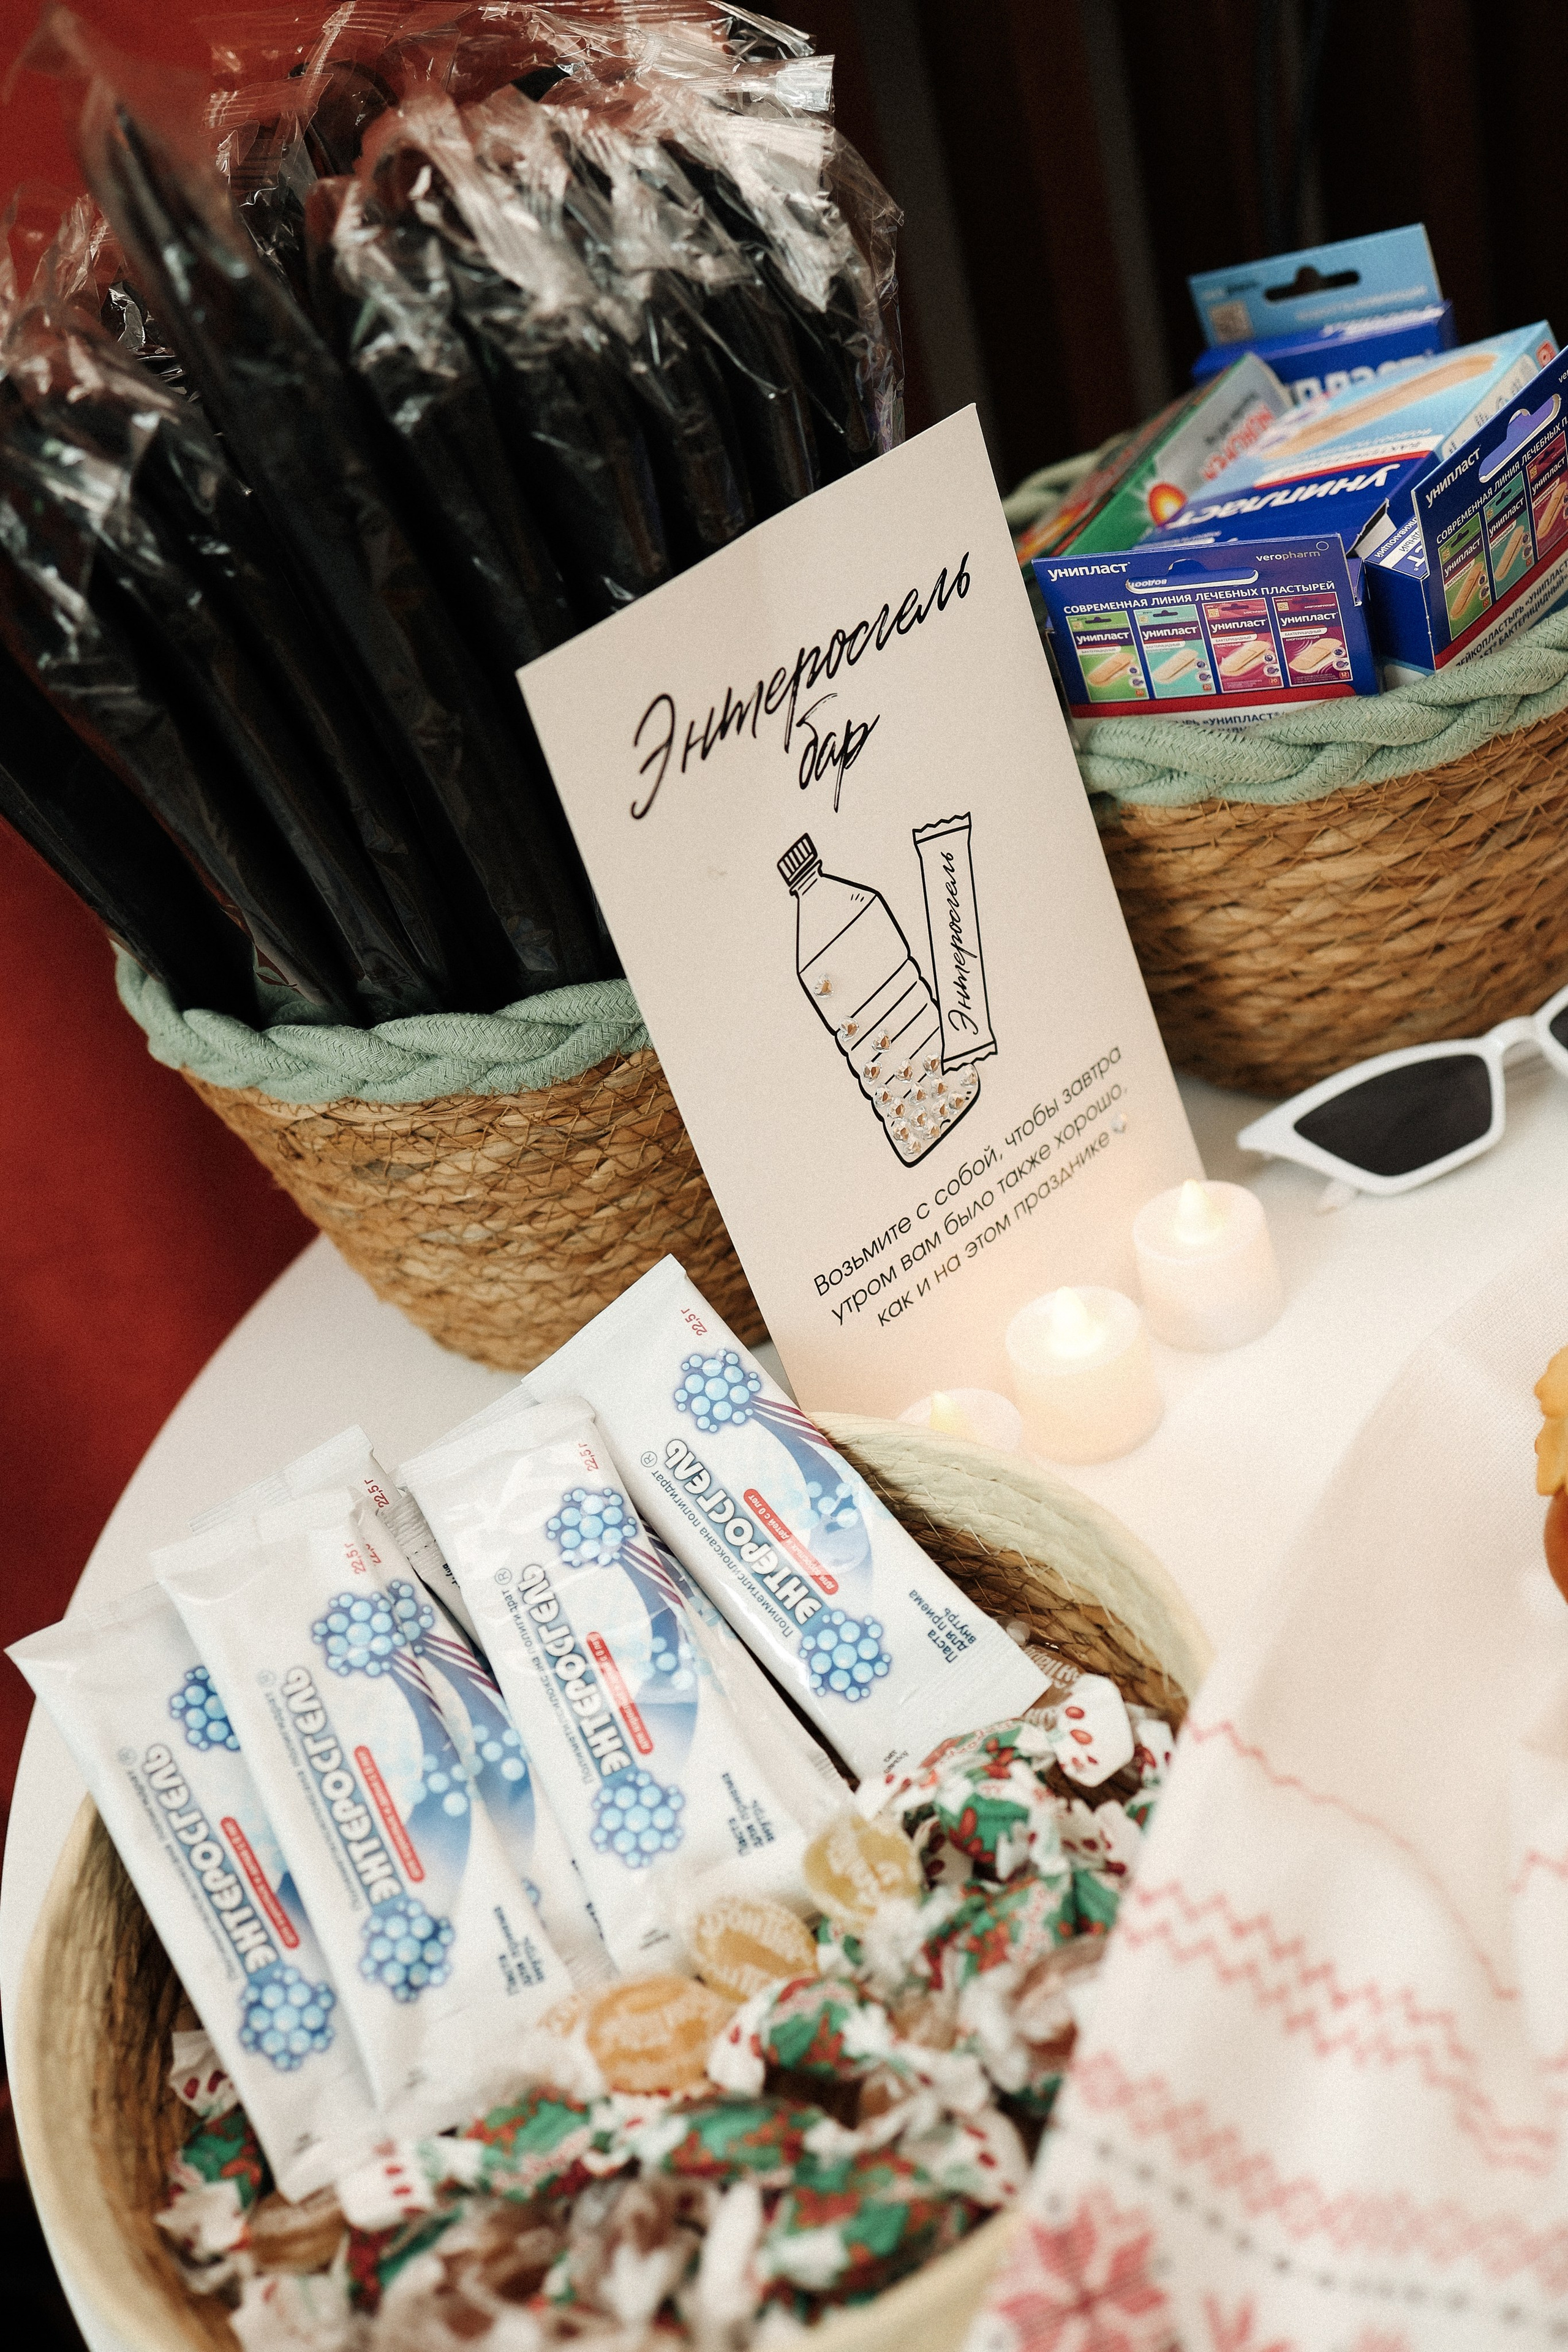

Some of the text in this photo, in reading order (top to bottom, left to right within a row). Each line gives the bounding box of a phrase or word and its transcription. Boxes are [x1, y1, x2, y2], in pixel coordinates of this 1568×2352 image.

[1425, 448, 1480, 508] унипласт
[1436, 487, 1492, 545] СОВРЕМЕННАЯ
[1494, 462, 1520, 492] ЛИНИЯ
[1521, 423, 1561, 466] ЛЕЧЕБНЫХ
[1532, 457, 1565, 496] унипласт
[1489, 498, 1525, 538] унипласт
[1048, 563, 1128, 581] унипласт
[1256, 551, 1321, 562] veropharm
[1444, 538, 1480, 578] унипласт
[1063, 581, 1335, 614] СОВРЕМЕННАЯ ЛИНИЯ ЛЕЧЕБНЫХ ПЛАСТЫРЕЙ
[1076, 631, 1129, 644] унипласт
[1142, 626, 1197, 640] унипласт
[1211, 619, 1266, 633] унипласт
[1280, 612, 1336, 627] унипласт
[631, 551, 970, 820] Энтеросгель
[796, 693, 880, 813] бар
[940, 851, 979, 1035] Энтеросгель
[813, 1046, 1121, 1297] Возьмите с собой, чтобы завтра
[832, 1083, 1129, 1325] утром вам было также хорошо,
[877, 1132, 1110, 1327] как и на этом празднике
[685, 1314, 707, 1336] 22,5
[579, 1449, 598, 1471] 22,5
[368, 1485, 390, 1508] 22,5
[748, 1493, 761, 1509] лет
[665, 1439, 823, 1625] ЭНТЕРОСГЕЛЬ
[769, 1518, 791, 1540] детей
[346, 1550, 366, 1574] 22,5
[652, 1471, 793, 1637] Полиметилсилоксана полигидрат
[909, 1589, 969, 1651] для приема
[944, 1608, 976, 1645] внутрь
[927, 1629, 958, 1663] Паста
[518, 1564, 632, 1776] ЭНТЕРОСГЕЛЬ
[282, 1667, 402, 1905] ЭНТЕРОСГЕЛЬ
[142, 1743, 279, 1973] ЭНТЕРОСГЕЛЬ
